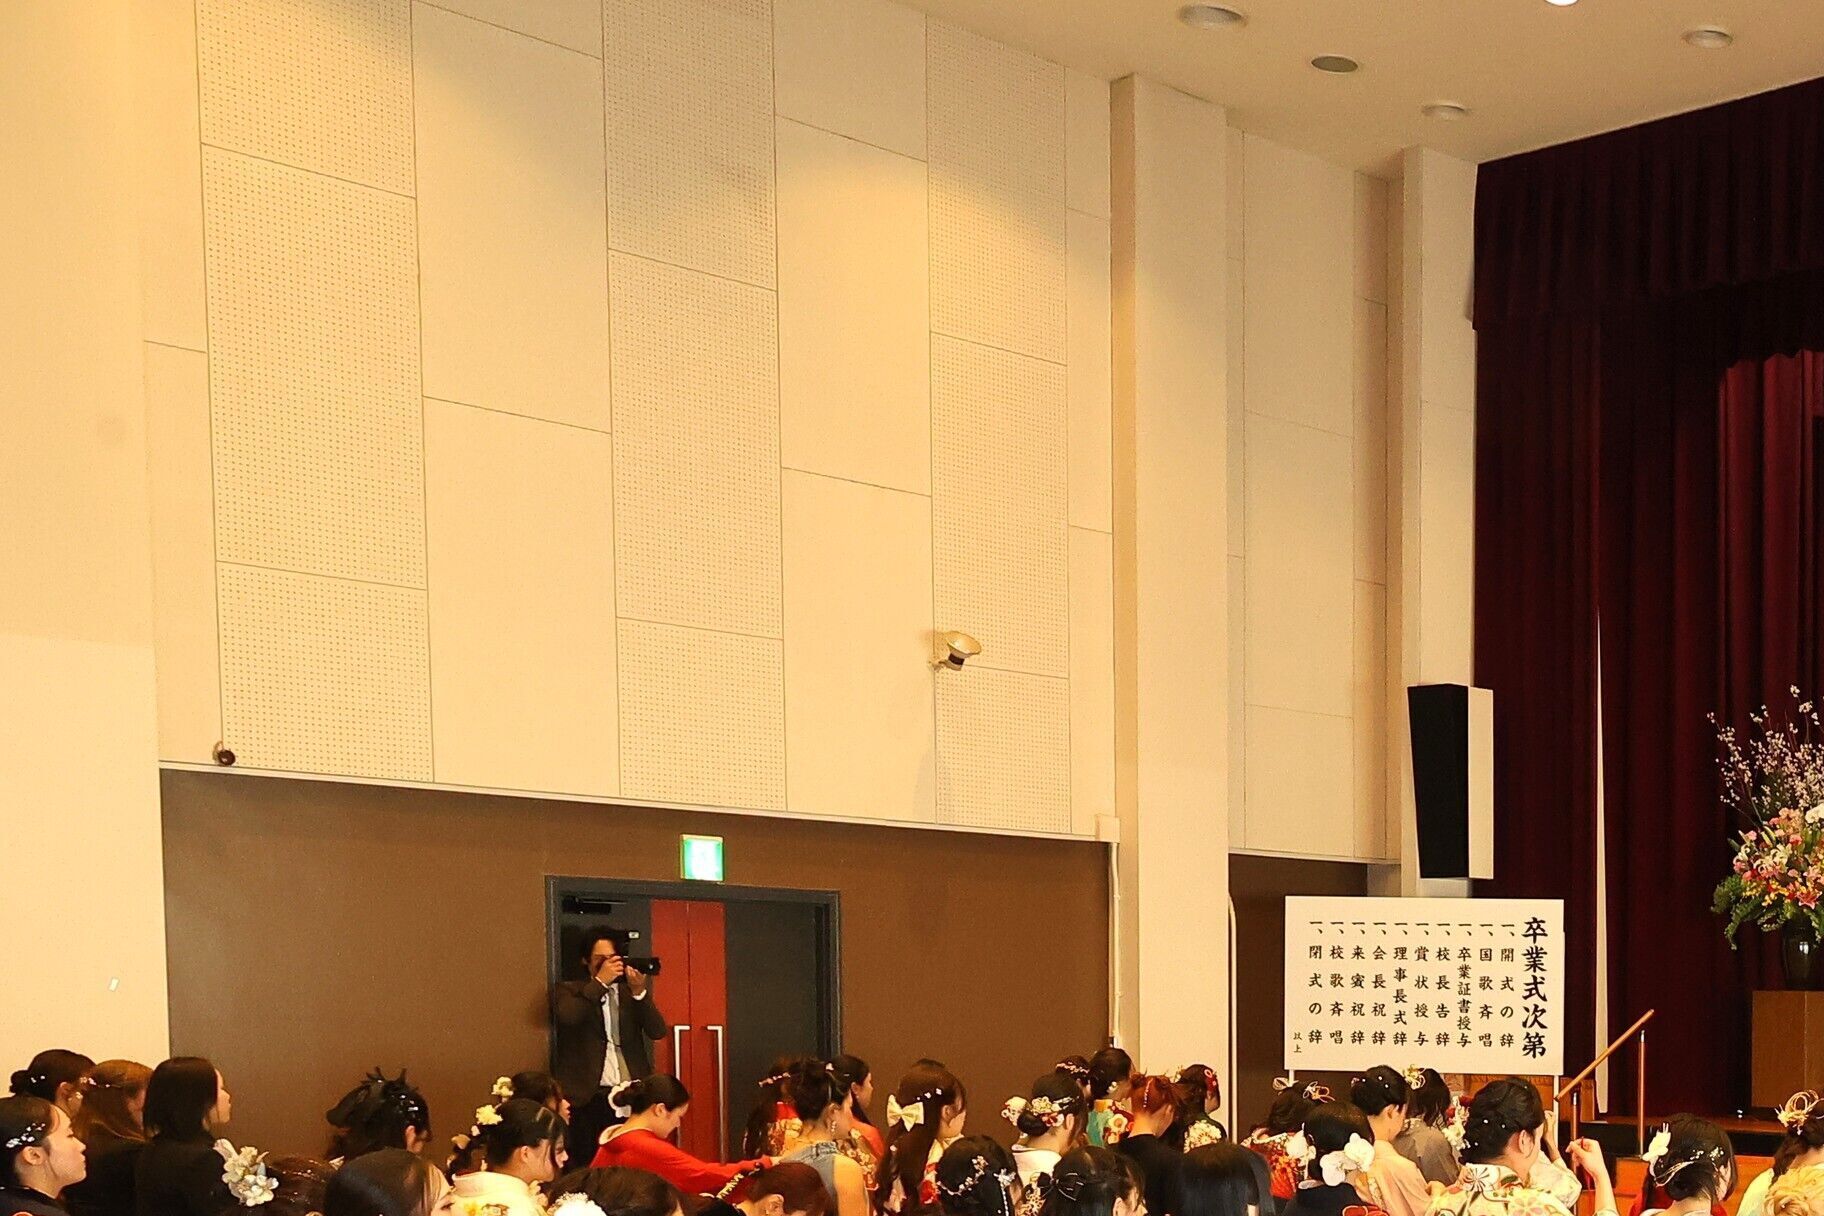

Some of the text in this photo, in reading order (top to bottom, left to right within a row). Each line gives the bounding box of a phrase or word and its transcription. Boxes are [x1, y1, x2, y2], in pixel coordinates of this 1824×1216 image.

[1521, 916, 1549, 1059] 卒業式次第
[1293, 1031, 1303, 1053] 以上
